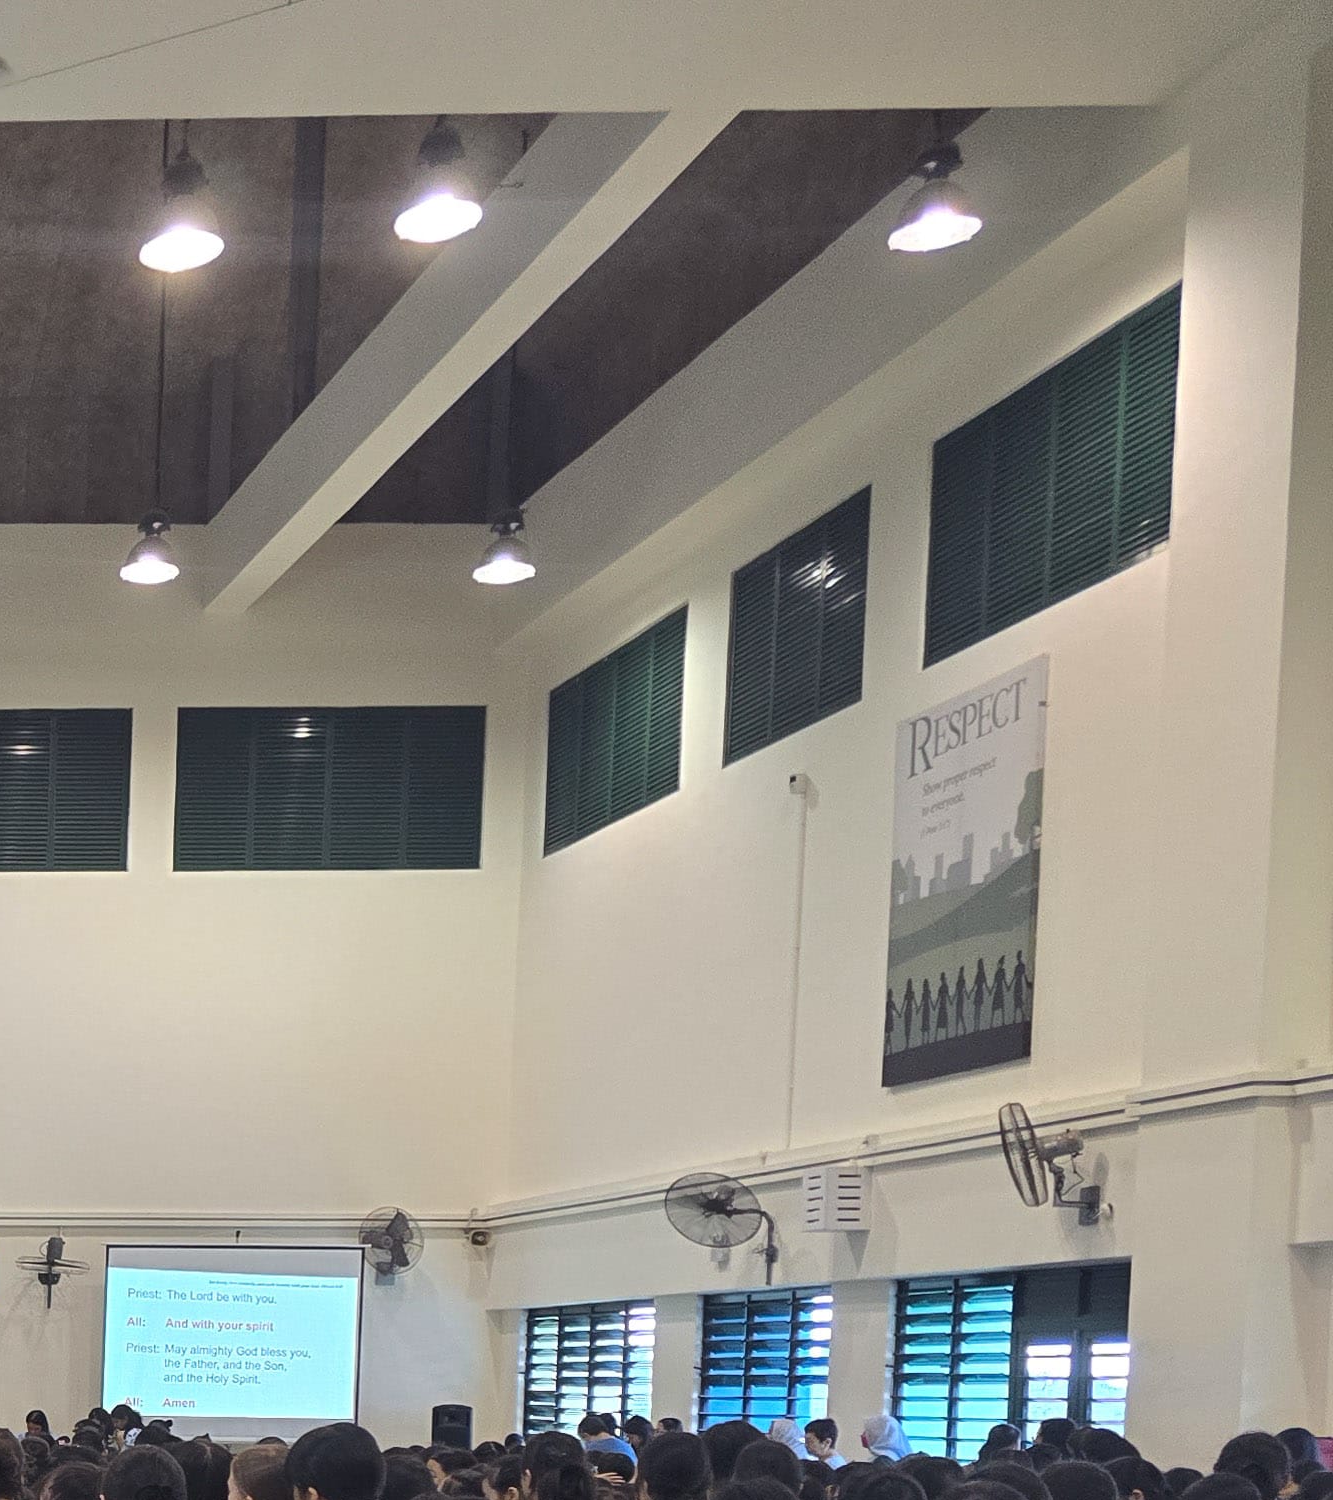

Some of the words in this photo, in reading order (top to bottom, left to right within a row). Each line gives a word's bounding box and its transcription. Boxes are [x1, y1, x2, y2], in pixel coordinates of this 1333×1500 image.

[907, 678, 1027, 780] RESPECT
[128, 1288, 162, 1299] Priest:
[167, 1290, 187, 1300] The
[190, 1291, 213, 1301] Lord
[216, 1291, 229, 1302] be
[232, 1292, 253, 1303] with
[255, 1295, 277, 1305] you.
[127, 1317, 146, 1327] All:
[165, 1318, 188, 1328] And
[191, 1319, 214, 1329] with
[217, 1321, 243, 1332] your
[126, 1343, 160, 1353] Priest:
[165, 1344, 187, 1356] May
[190, 1345, 232, 1358] almighty
[236, 1346, 258, 1357] God
[261, 1347, 287, 1357] bless
[289, 1349, 311, 1360] you,
[164, 1359, 180, 1368] the
[223, 1359, 242, 1370] and
[245, 1360, 261, 1370] the
[163, 1373, 183, 1383] and
[186, 1373, 202, 1383] the
[206, 1374, 229, 1386] Holy
[162, 1398, 195, 1408] Amen
